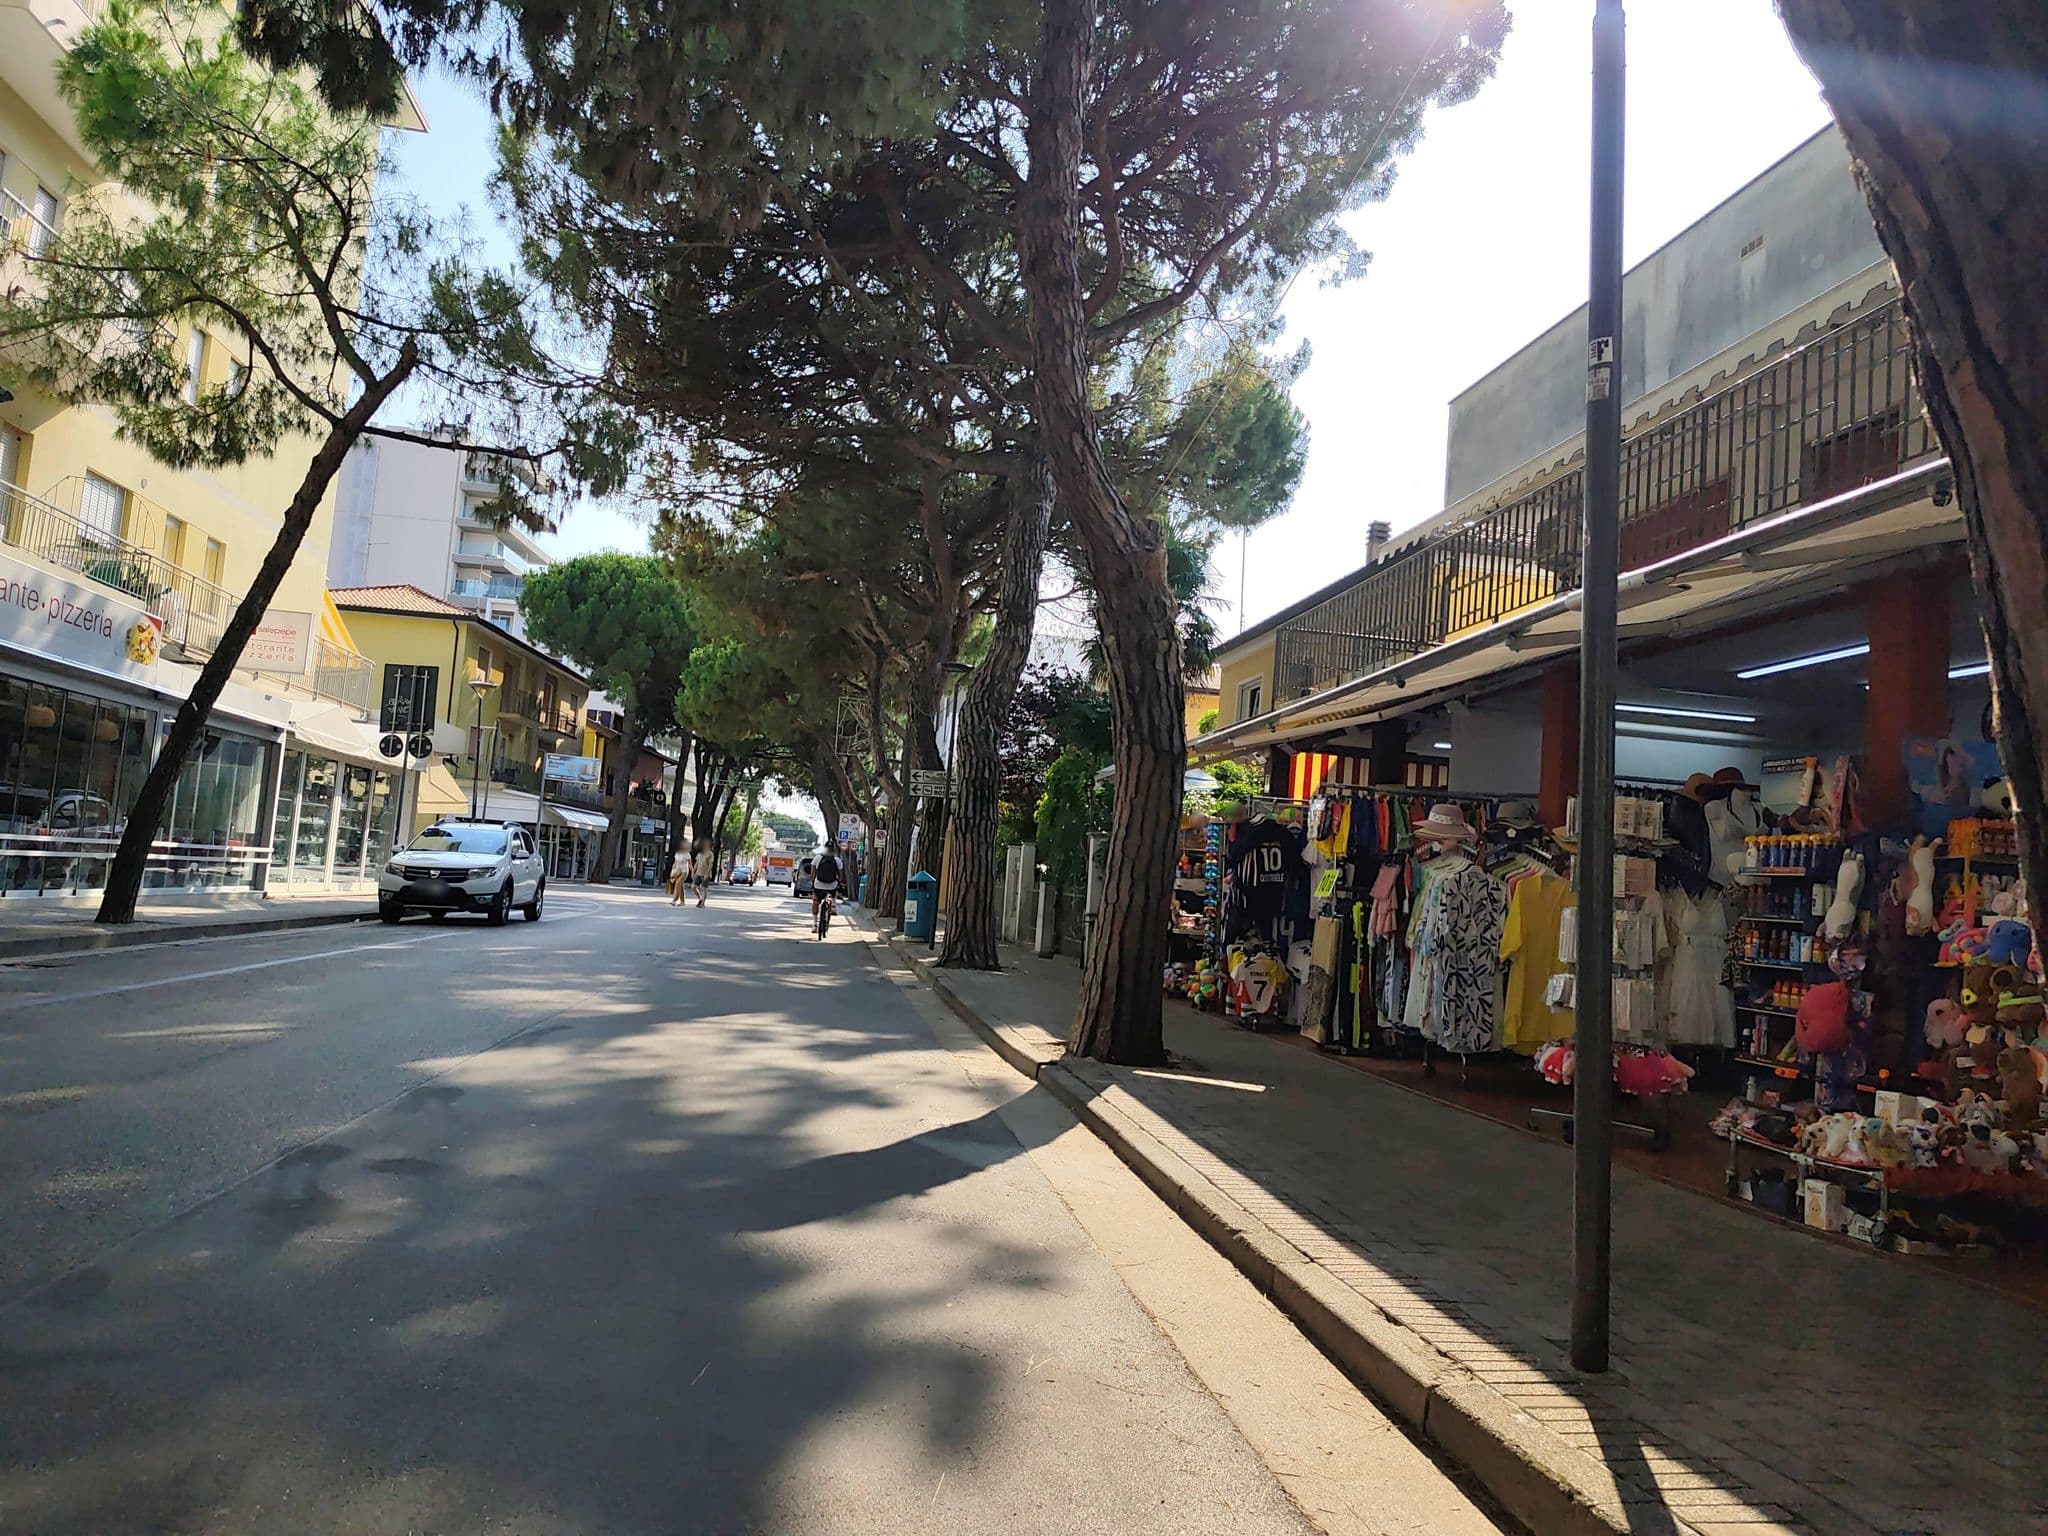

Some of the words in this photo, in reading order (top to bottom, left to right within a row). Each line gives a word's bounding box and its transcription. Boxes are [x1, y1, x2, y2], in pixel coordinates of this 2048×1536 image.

[48, 595, 113, 638] pizzeria
[247, 643, 295, 653] torante
[1261, 847, 1282, 872] 10
[1253, 980, 1268, 1001] 7
